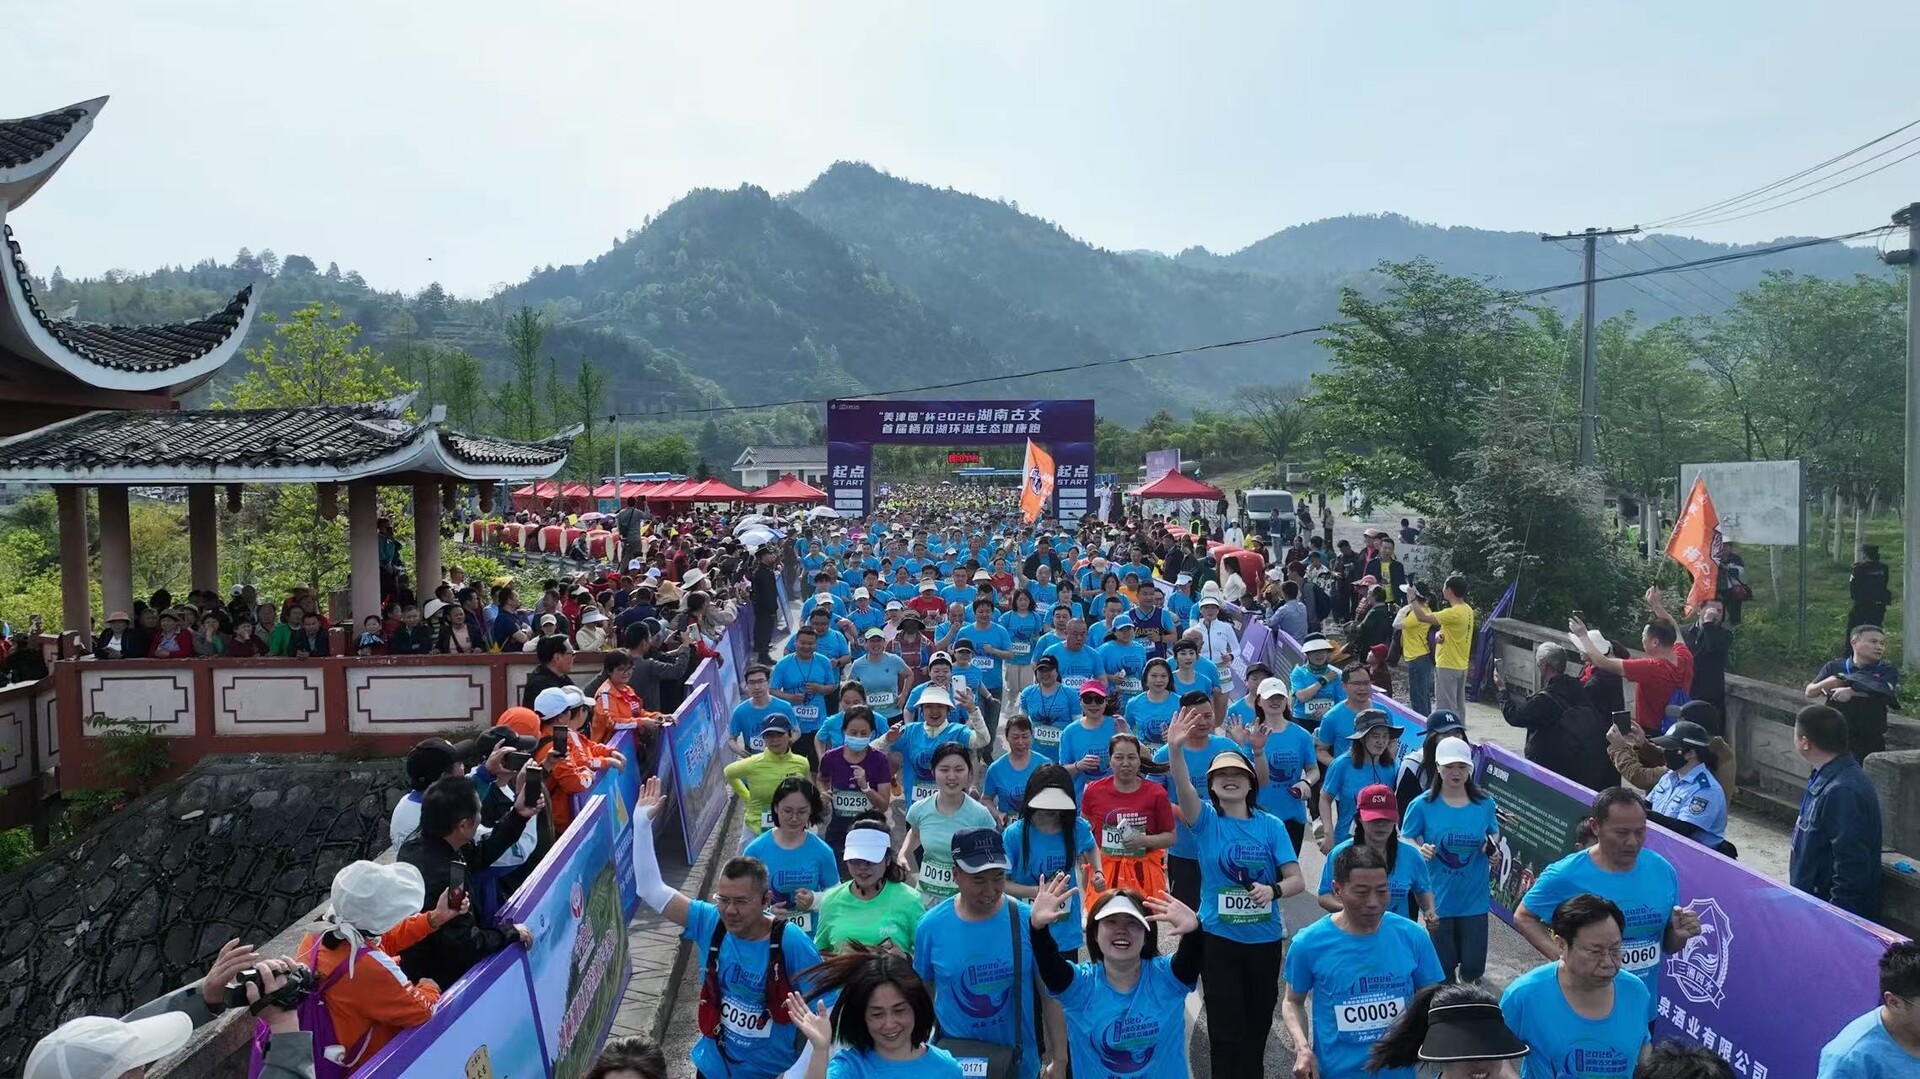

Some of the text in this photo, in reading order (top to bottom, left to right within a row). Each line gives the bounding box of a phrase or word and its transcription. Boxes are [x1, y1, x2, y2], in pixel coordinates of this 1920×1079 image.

[882, 423, 1041, 435] 首届栖凤湖环湖生态健康跑
[832, 465, 865, 478] 起点
[1057, 464, 1089, 478] 起点
[833, 479, 864, 487] START
[1057, 478, 1089, 486] START
[869, 694, 890, 704] D0227
[796, 707, 817, 717] C0137
[1036, 728, 1060, 739] D0151
[836, 796, 868, 808] D0258
[1371, 795, 1387, 804] GSW
[925, 865, 956, 882] D019
[1226, 896, 1265, 911] D02
[721, 1003, 766, 1031] C030
[1344, 1002, 1398, 1024] C0003
